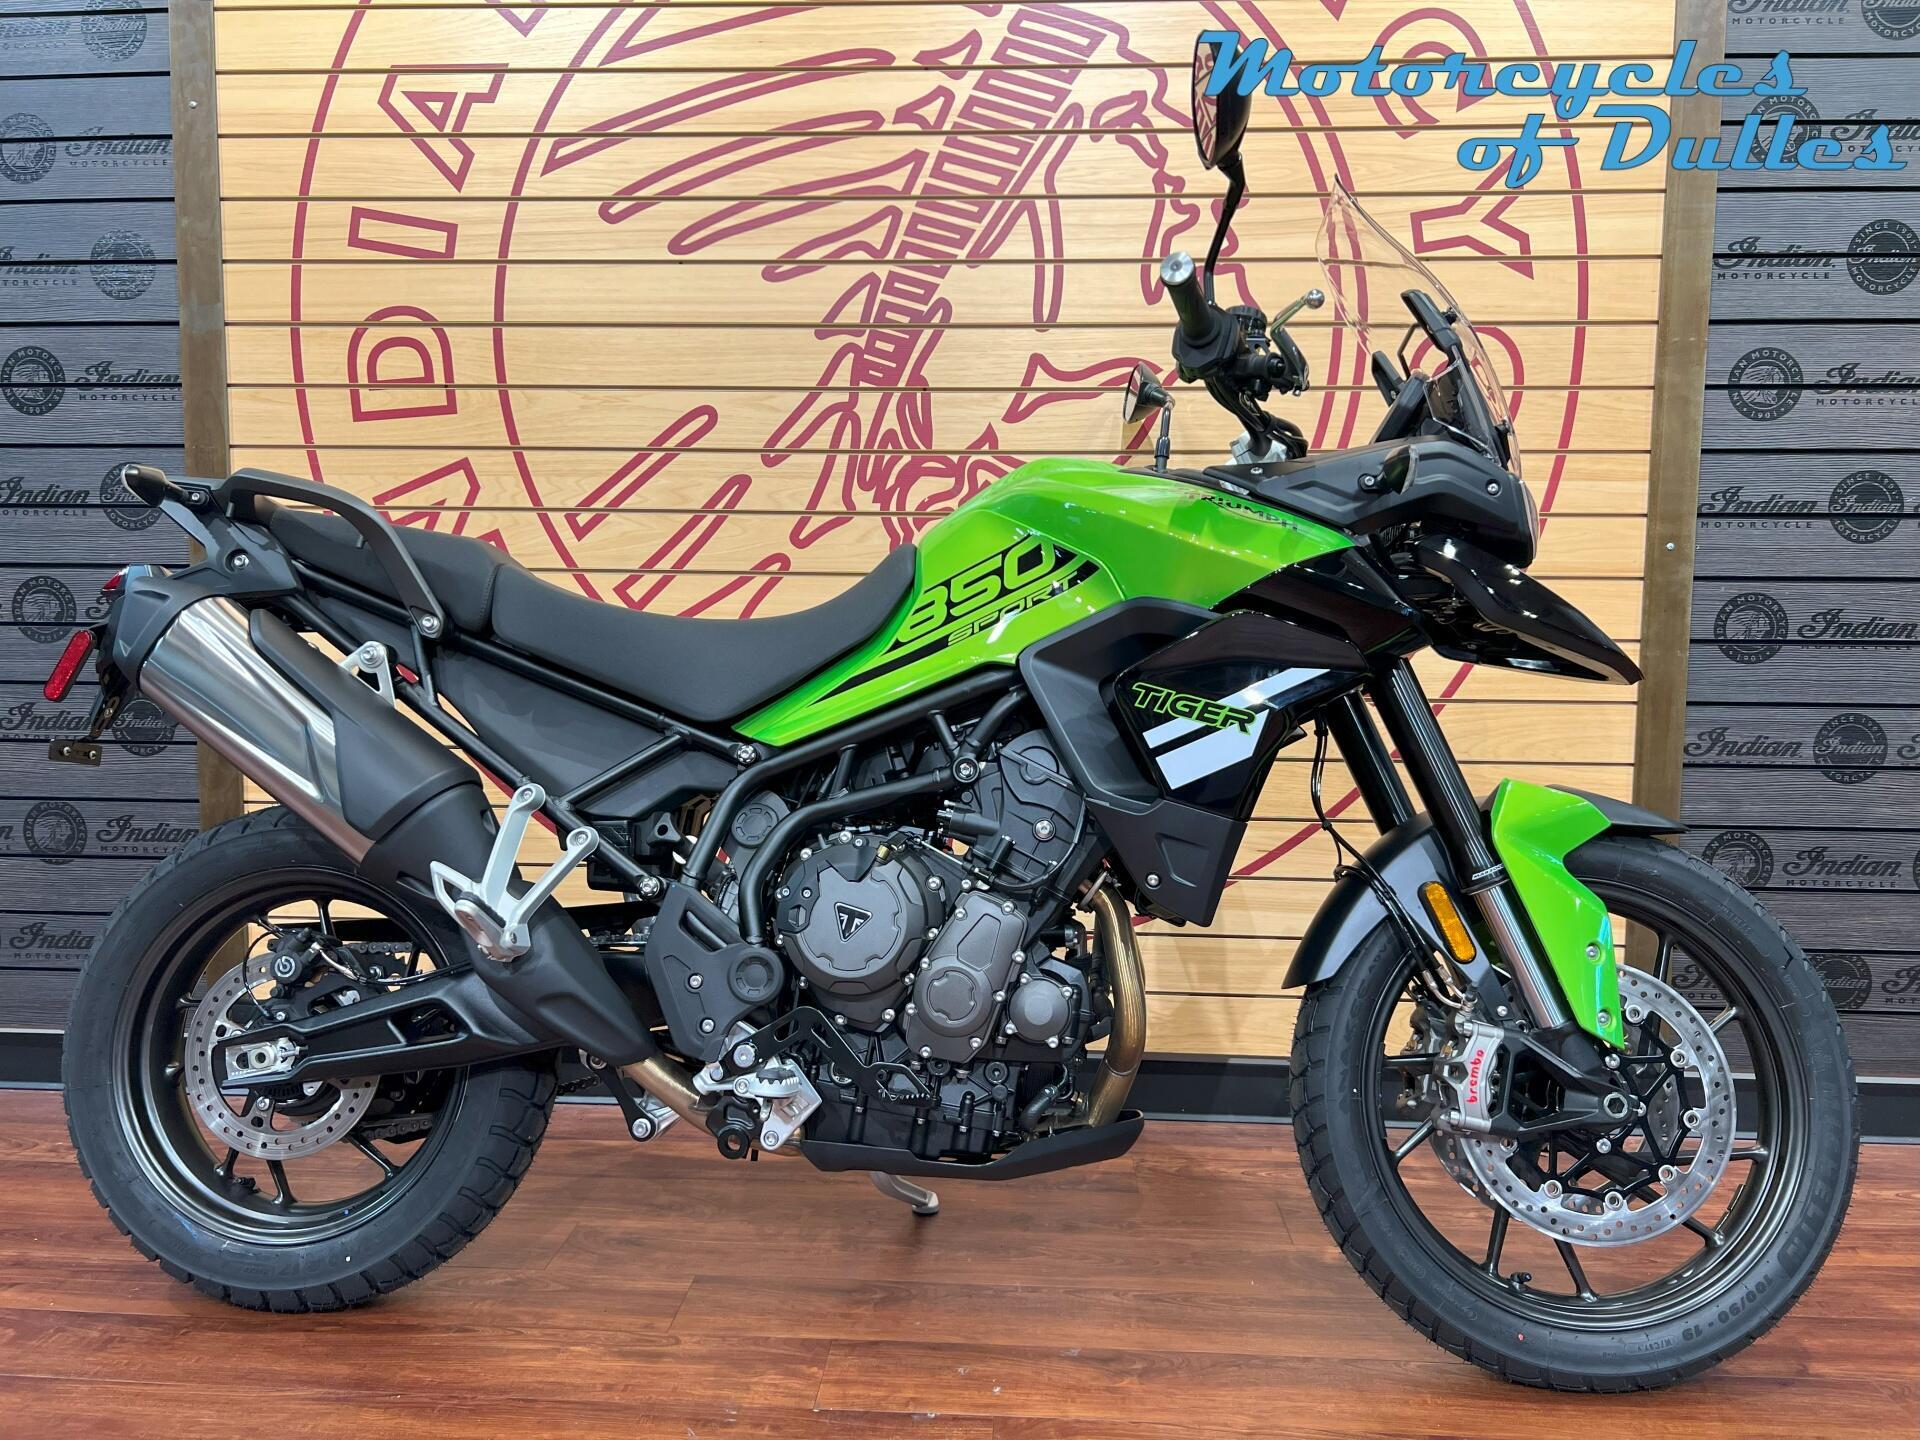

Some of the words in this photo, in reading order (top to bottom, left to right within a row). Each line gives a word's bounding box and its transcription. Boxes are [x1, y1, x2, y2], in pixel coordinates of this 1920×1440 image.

[1732, 17, 1845, 25] MOTORCYCLE
[1855, 222, 1889, 244] SINCE
[1717, 272, 1830, 280] MOTORCYCLE
[1851, 266, 1918, 293] MOTORCYCLE
[17, 349, 64, 402] MOTORCYLE
[74, 361, 182, 392] Indian
[1731, 361, 1749, 406] INIAN
[1751, 350, 1801, 405] MOTORCYLE
[0, 476, 90, 504] Indian
[1697, 486, 1818, 513] Indian
[897, 533, 1055, 643] 850
[948, 571, 1078, 646] SPORT
[1797, 609, 1917, 639] Indian
[1131, 682, 1256, 736] TIGER
[1684, 727, 1801, 757] Indian
[1817, 736, 1884, 755] Indian
[96, 815, 199, 843] Indian
[101, 845, 184, 853] MOTORCYC
[1783, 847, 1900, 876] Indian
[1786, 879, 1896, 888] MOTORCYCLE
[9, 922, 95, 949] India
[1466, 1050, 1484, 1104] brembo
[1717, 1274, 1776, 1325] 100/90
[1681, 1325, 1703, 1343] 19
